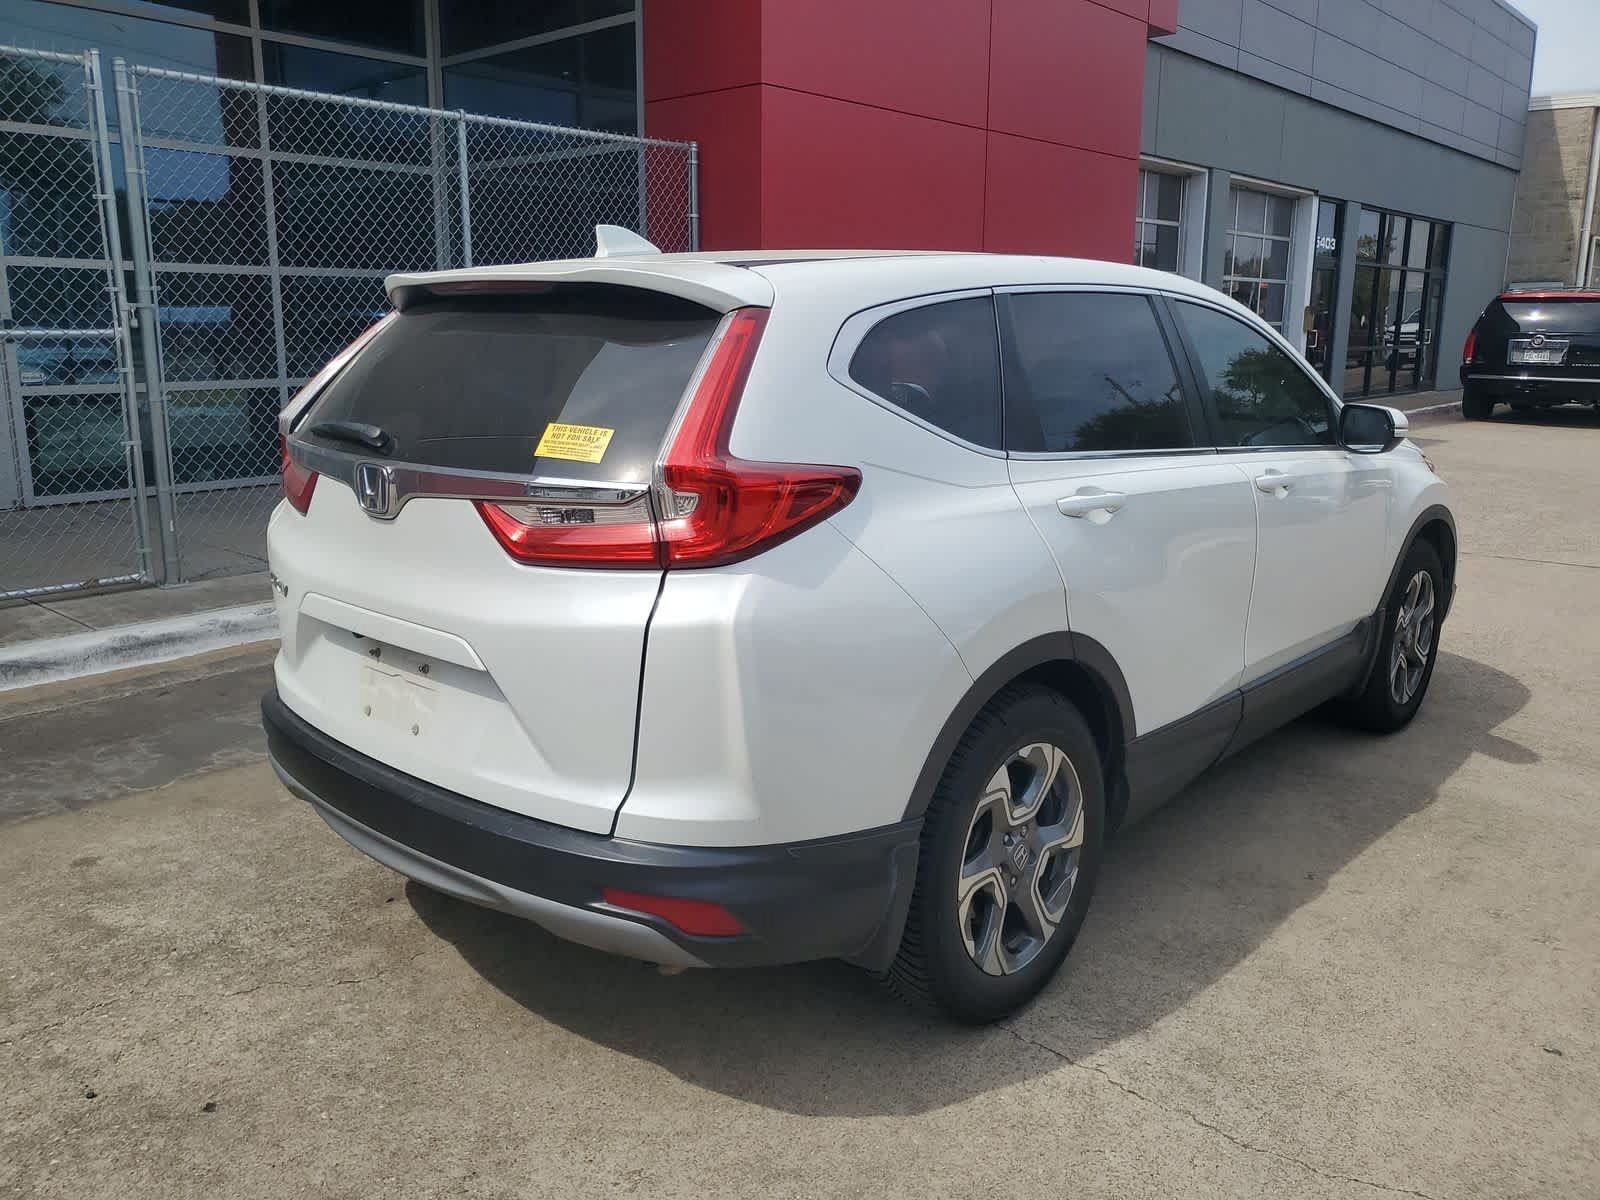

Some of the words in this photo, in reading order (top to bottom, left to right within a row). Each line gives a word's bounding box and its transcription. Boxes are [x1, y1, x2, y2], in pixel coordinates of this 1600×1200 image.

[552, 425, 568, 433] THIS
[569, 426, 598, 436] VEHICLE
[582, 435, 601, 443] SALE
